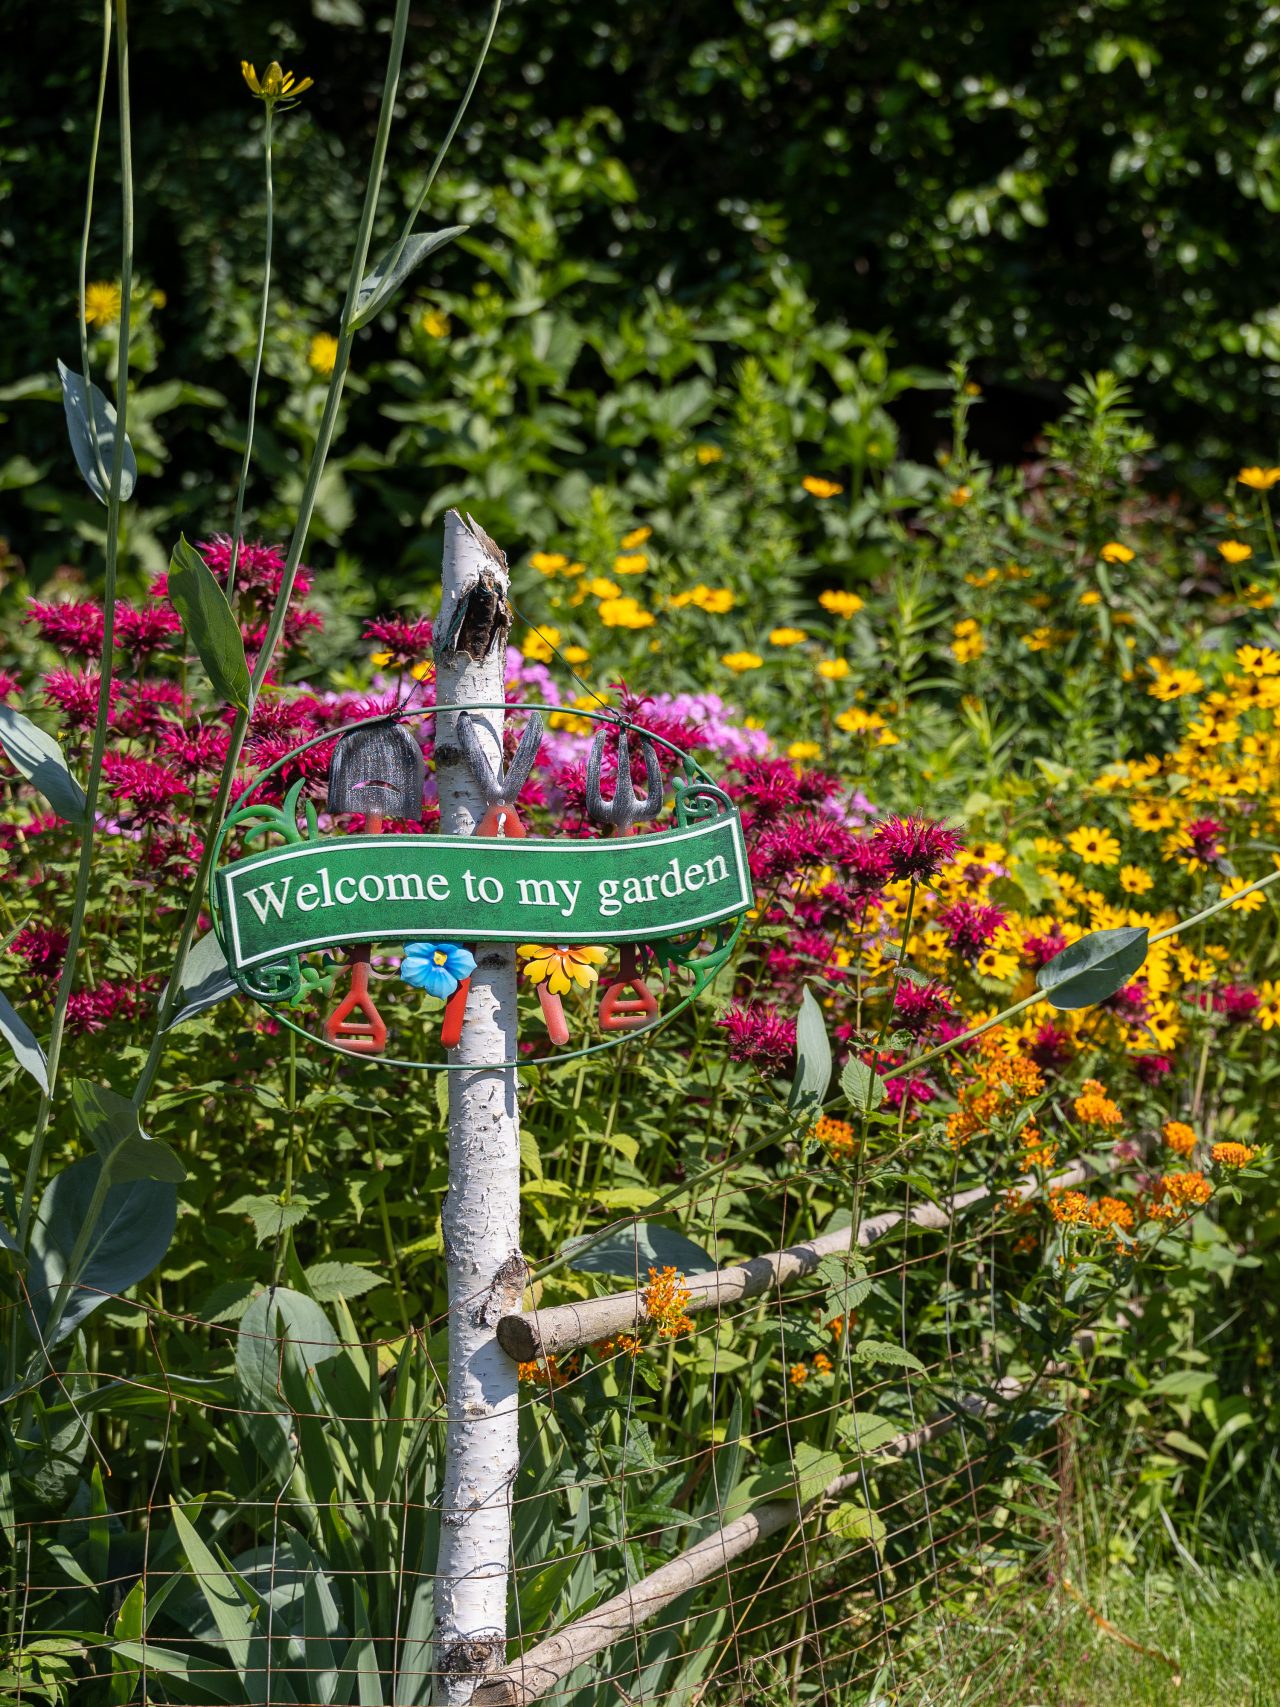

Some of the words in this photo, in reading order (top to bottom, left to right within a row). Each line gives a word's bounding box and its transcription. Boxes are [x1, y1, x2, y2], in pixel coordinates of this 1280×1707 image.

[242, 867, 451, 926] Welcome
[463, 869, 504, 905] to
[518, 878, 582, 917] my
[598, 854, 730, 917] garden
